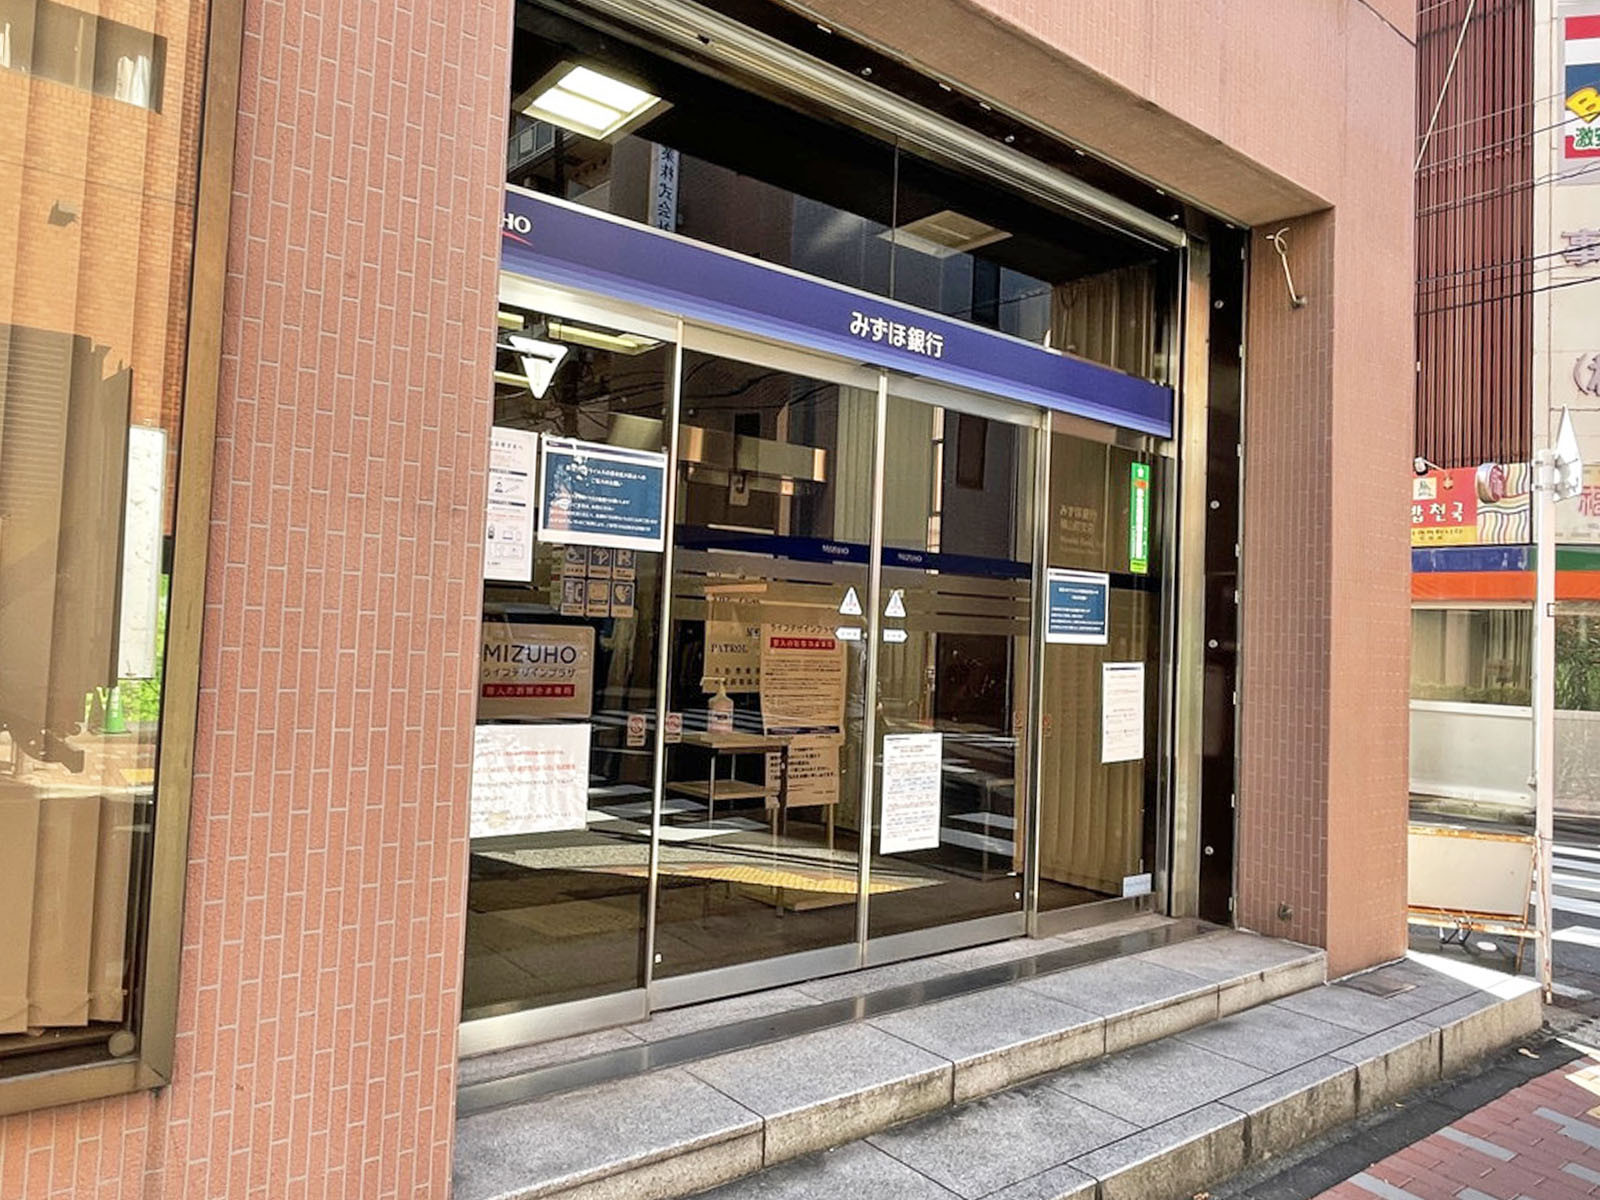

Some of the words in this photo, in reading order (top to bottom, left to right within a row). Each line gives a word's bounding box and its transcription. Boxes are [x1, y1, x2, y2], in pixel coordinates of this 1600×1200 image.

[850, 311, 944, 358] みずほ銀行
[483, 643, 577, 664] MIZUHO
